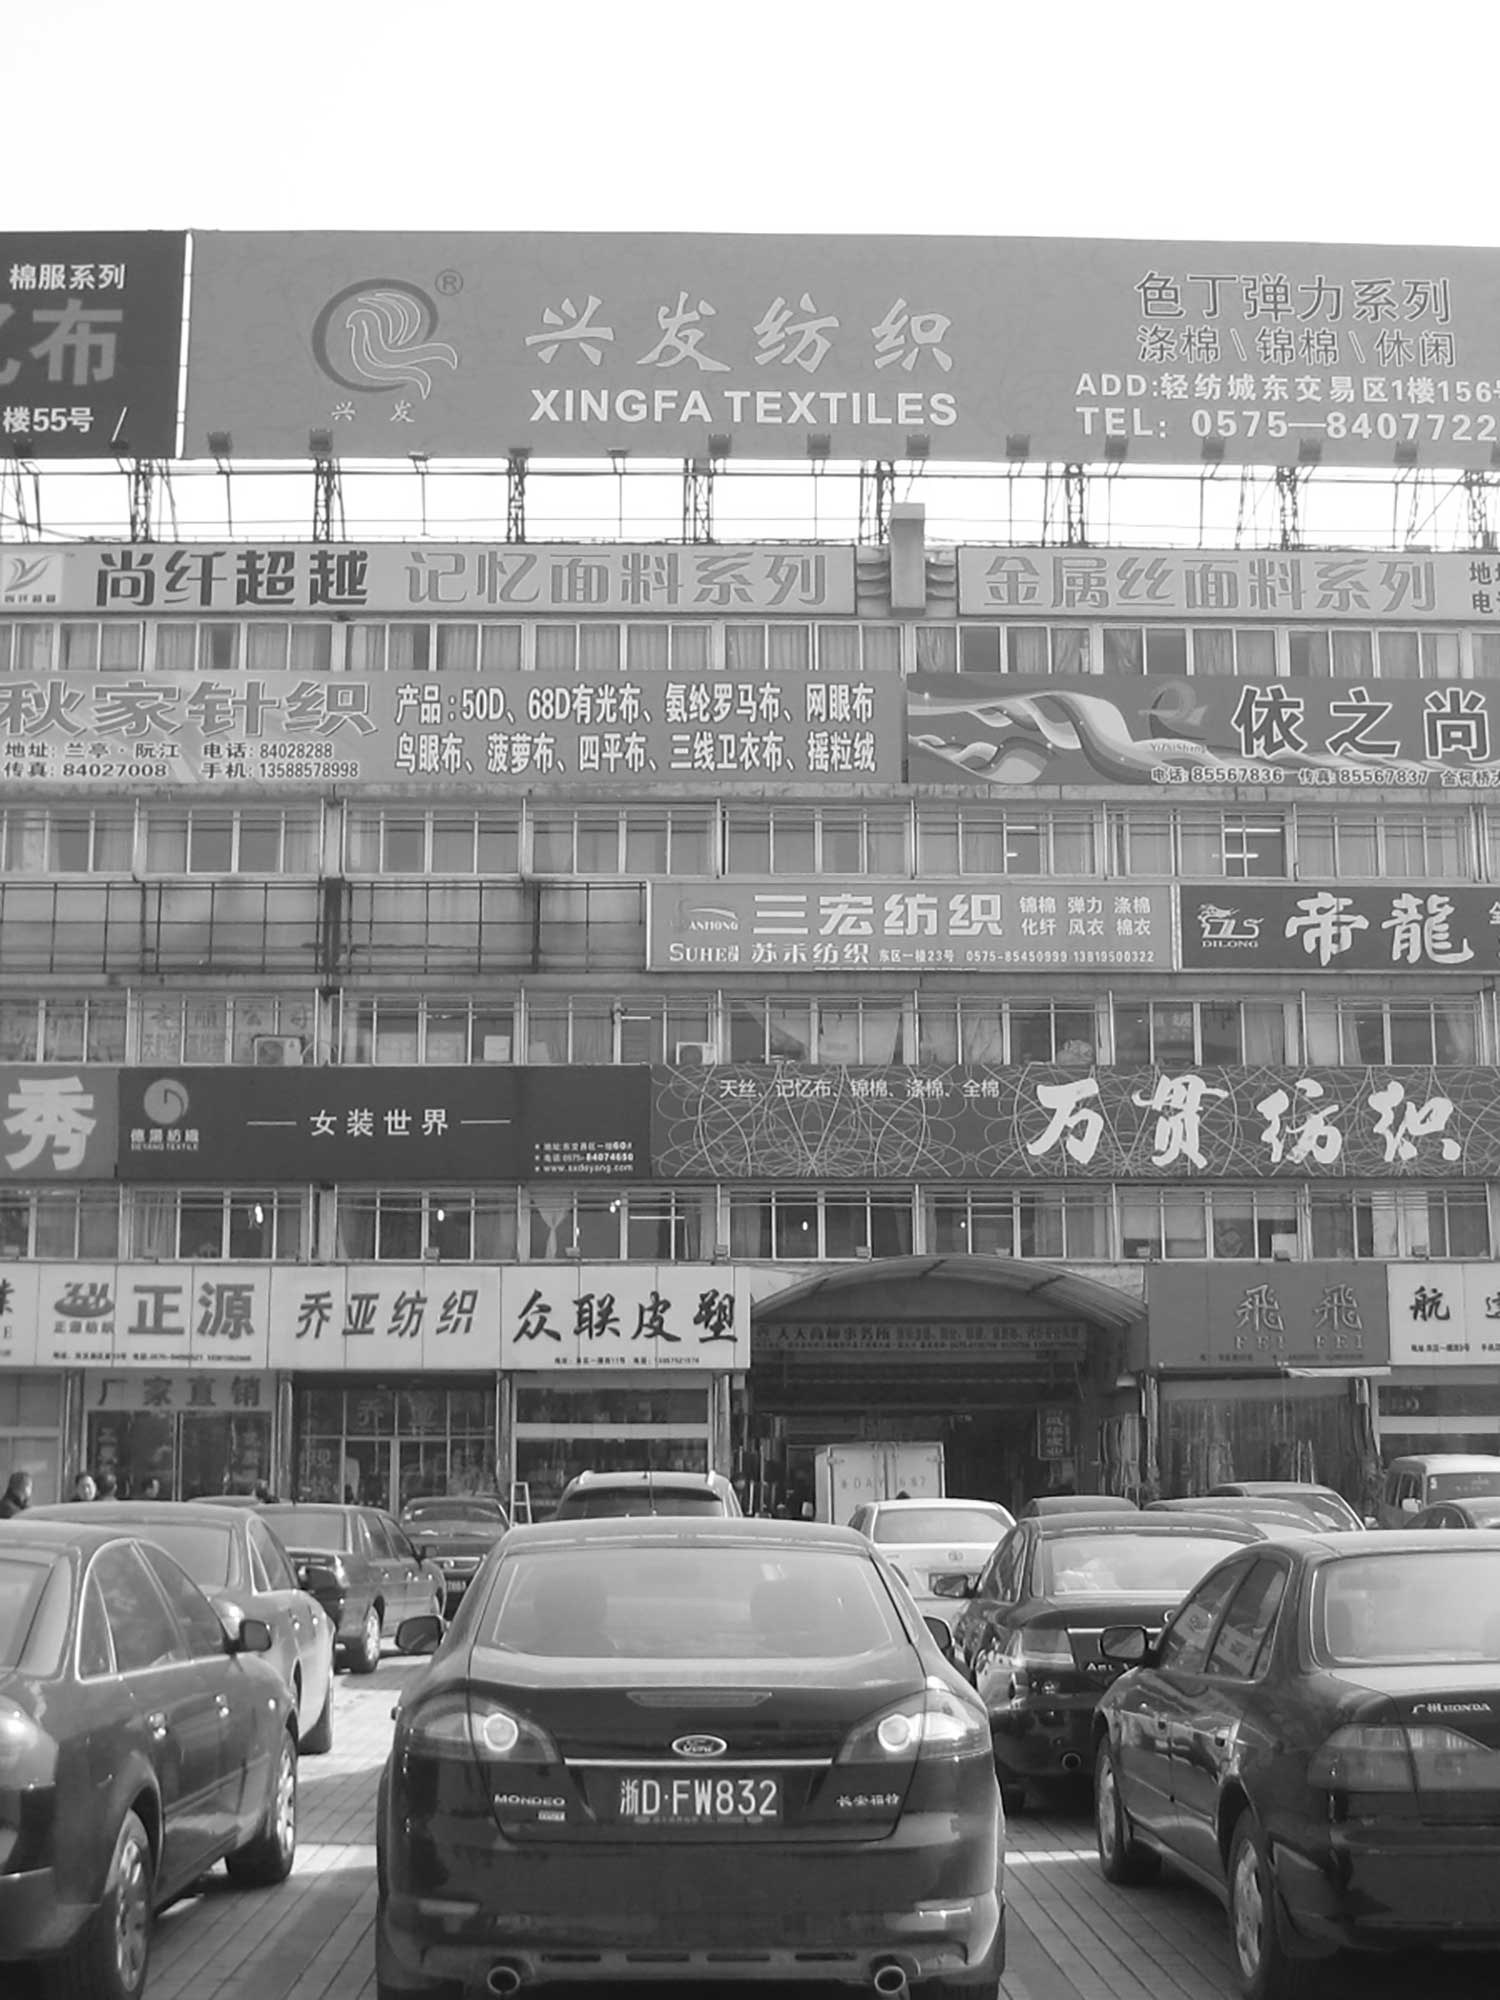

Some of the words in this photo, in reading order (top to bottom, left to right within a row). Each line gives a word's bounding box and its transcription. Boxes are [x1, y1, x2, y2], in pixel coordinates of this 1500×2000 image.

[9, 264, 125, 291] 棉服系列
[1135, 271, 1451, 323] 色丁弹力系列
[525, 291, 953, 373] 兴发纺织
[3, 406, 94, 433] 楼55号
[331, 402, 415, 423] 兴发
[530, 389, 713, 423] XINGFA
[723, 391, 958, 426] TEXTILES
[96, 549, 368, 607] 尚纤超越
[404, 550, 826, 606] 记忆面料系列
[984, 556, 1436, 612] 金属丝面料系列
[1472, 590, 1500, 614] 电
[0, 681, 377, 737] 秋家针织
[1232, 685, 1490, 759] 依之尚
[753, 893, 1002, 936] 三宏纺织
[1020, 896, 1056, 914] 锦棉
[1067, 896, 1103, 914] 弹力
[1114, 897, 1151, 914] 涤棉
[1021, 918, 1057, 936] 化纤
[1068, 919, 1104, 936] 风衣
[1116, 919, 1151, 936] 棉衣
[1285, 891, 1474, 966] 帝龍
[1202, 940, 1259, 948] DILONG
[6, 1077, 97, 1172] 秀
[310, 1109, 449, 1137] 女装世界
[128, 1282, 255, 1338] 正源
[295, 1290, 479, 1338] 乔亚纺织
[512, 1288, 739, 1343] 众联皮塑
[494, 1794, 565, 1806] MONDEO
